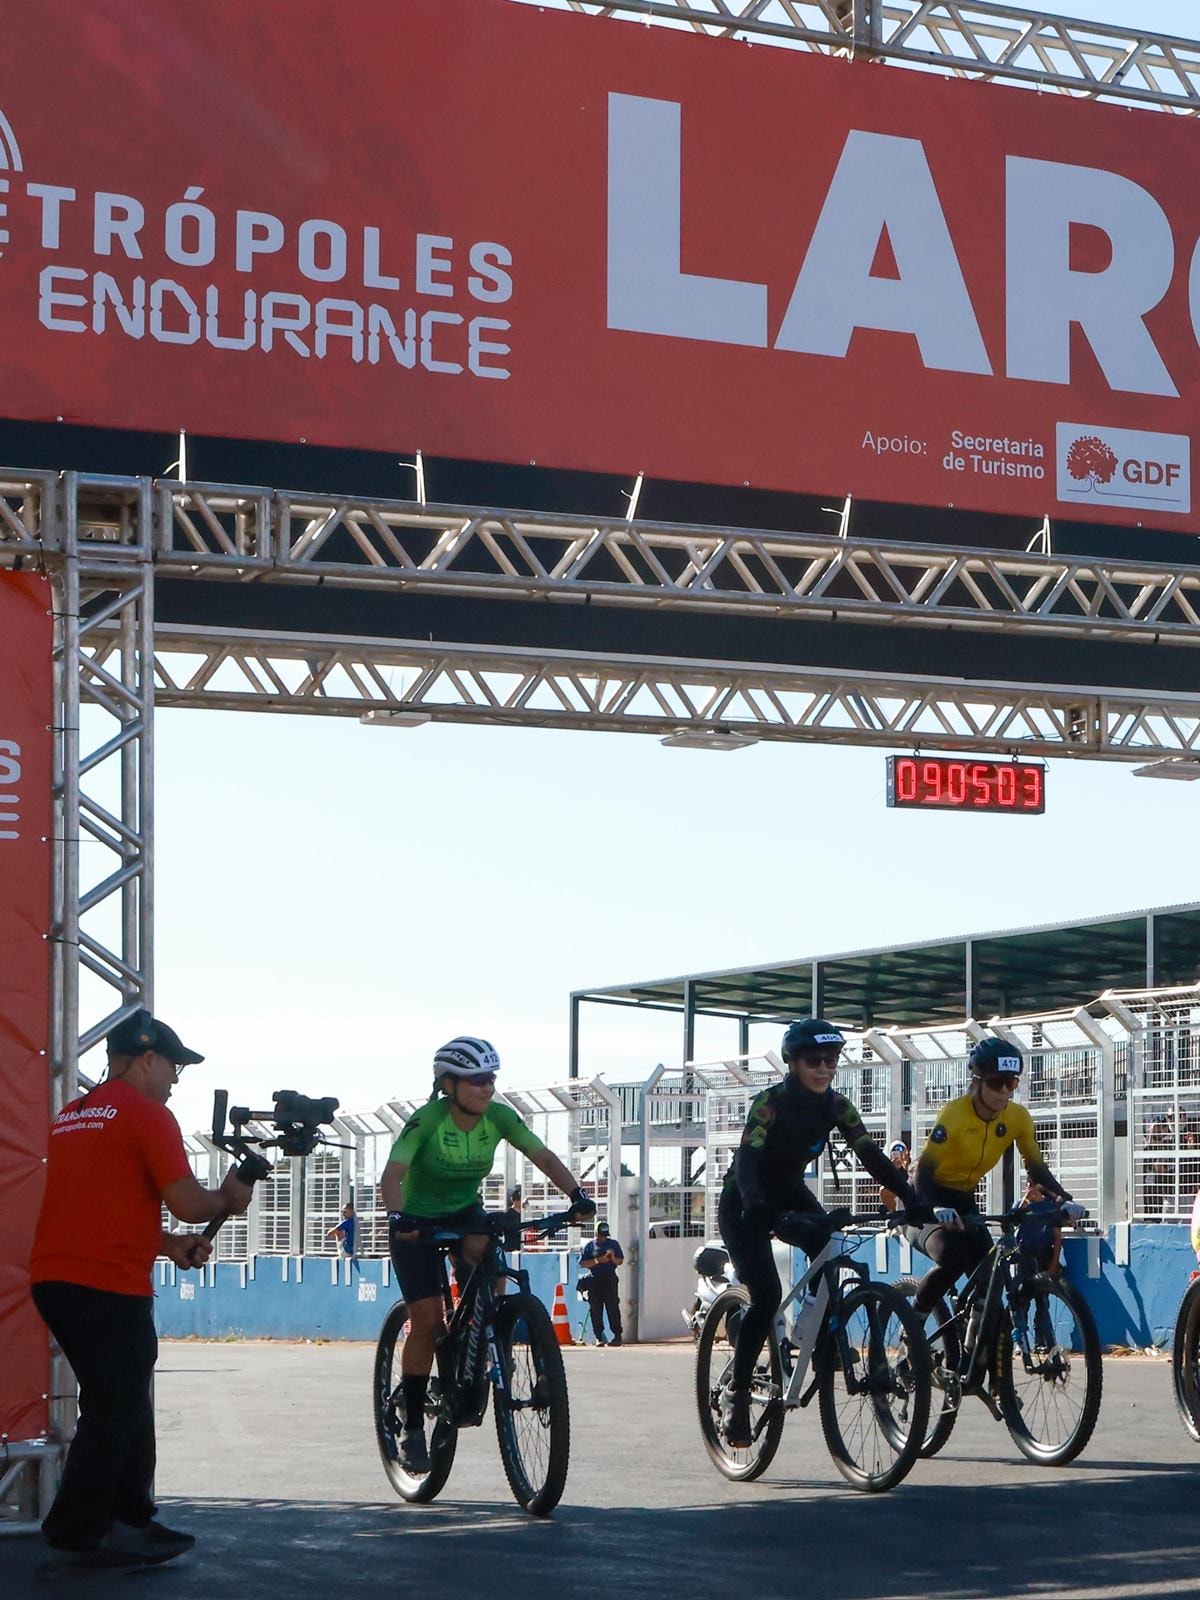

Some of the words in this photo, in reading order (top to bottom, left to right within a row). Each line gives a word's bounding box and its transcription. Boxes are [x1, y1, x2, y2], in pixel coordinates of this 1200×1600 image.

[0, 180, 513, 303] TRÓPOLES
[38, 265, 511, 379] ENDURANCE
[862, 431, 927, 455] Apoio:
[951, 431, 1044, 458] Secretaria
[943, 452, 965, 470] de
[970, 455, 1044, 480] Turismo
[1122, 458, 1180, 487] GDF
